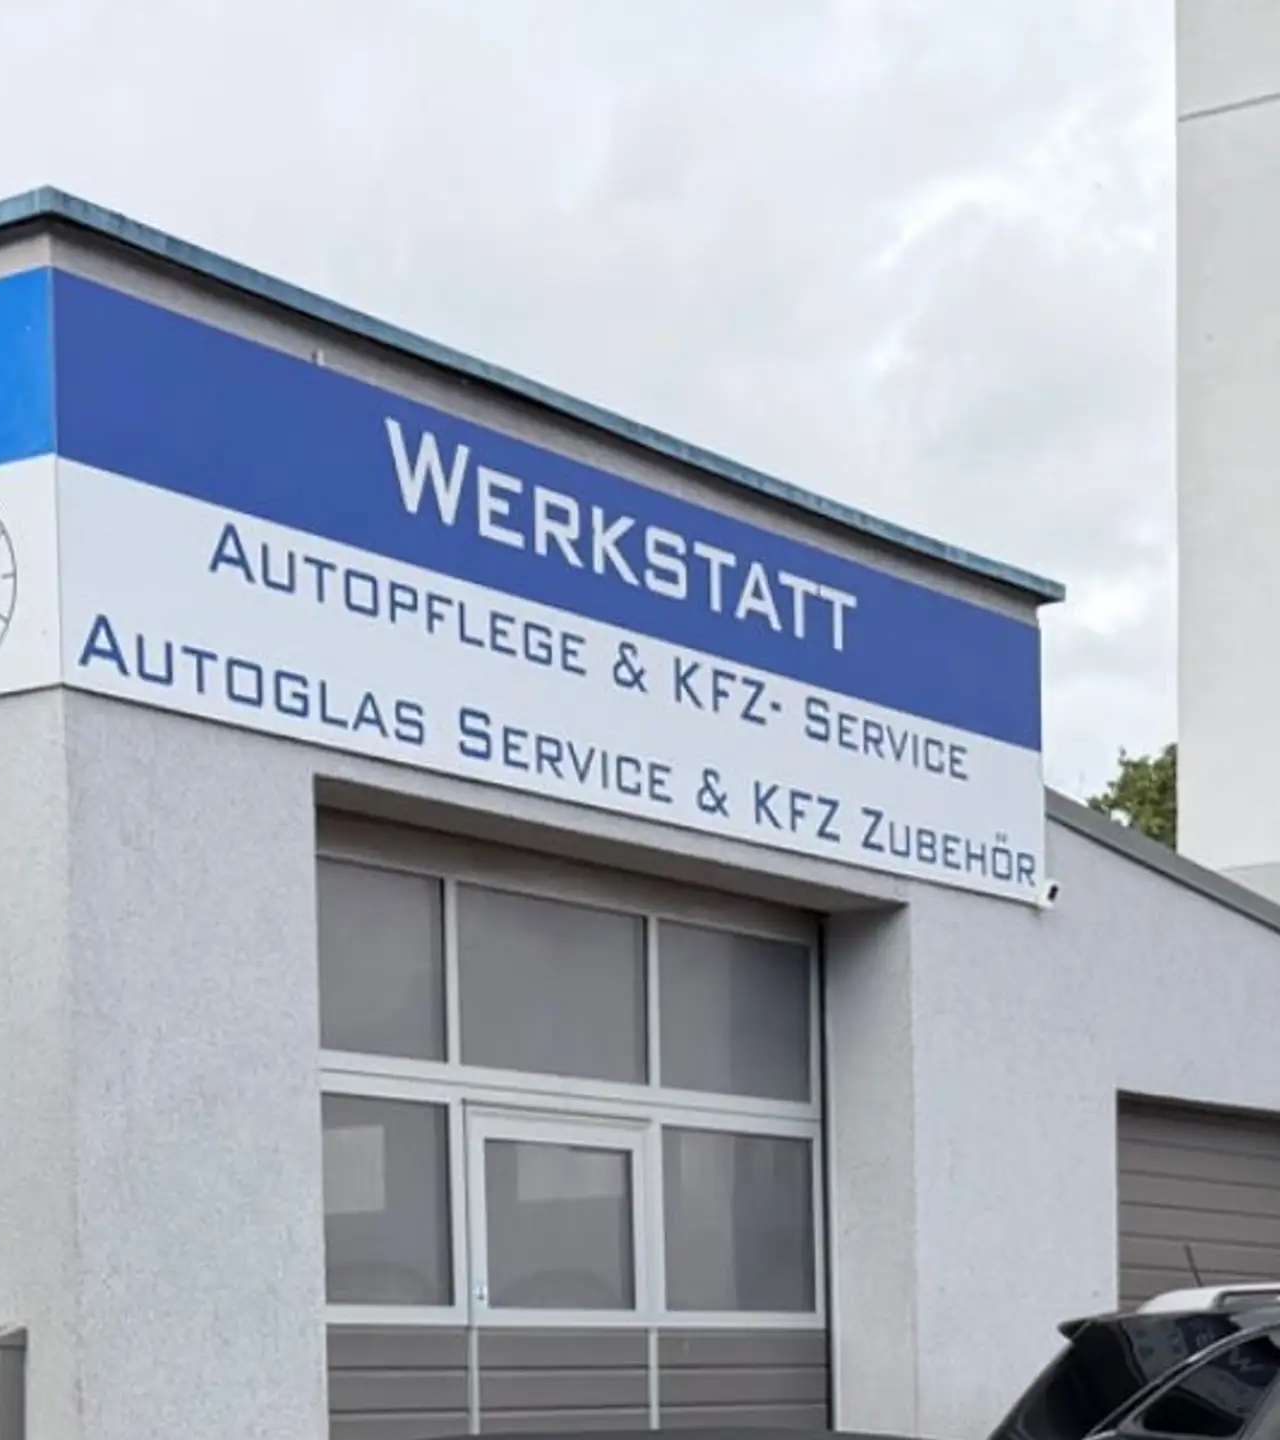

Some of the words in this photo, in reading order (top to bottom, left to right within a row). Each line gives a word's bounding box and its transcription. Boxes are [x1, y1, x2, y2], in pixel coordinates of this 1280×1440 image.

[210, 523, 586, 675] AUTOPFLEGE
[613, 642, 647, 692] &
[675, 657, 781, 725] KFZ-
[805, 697, 970, 780] SERVICE
[386, 419, 856, 650] WERKSTATT
[79, 615, 424, 745] AUTOGLAS
[459, 708, 672, 803] SERVICE
[698, 768, 728, 816] &
[755, 781, 840, 842] KFZ
[862, 808, 1036, 887] ZUBEHÖR
